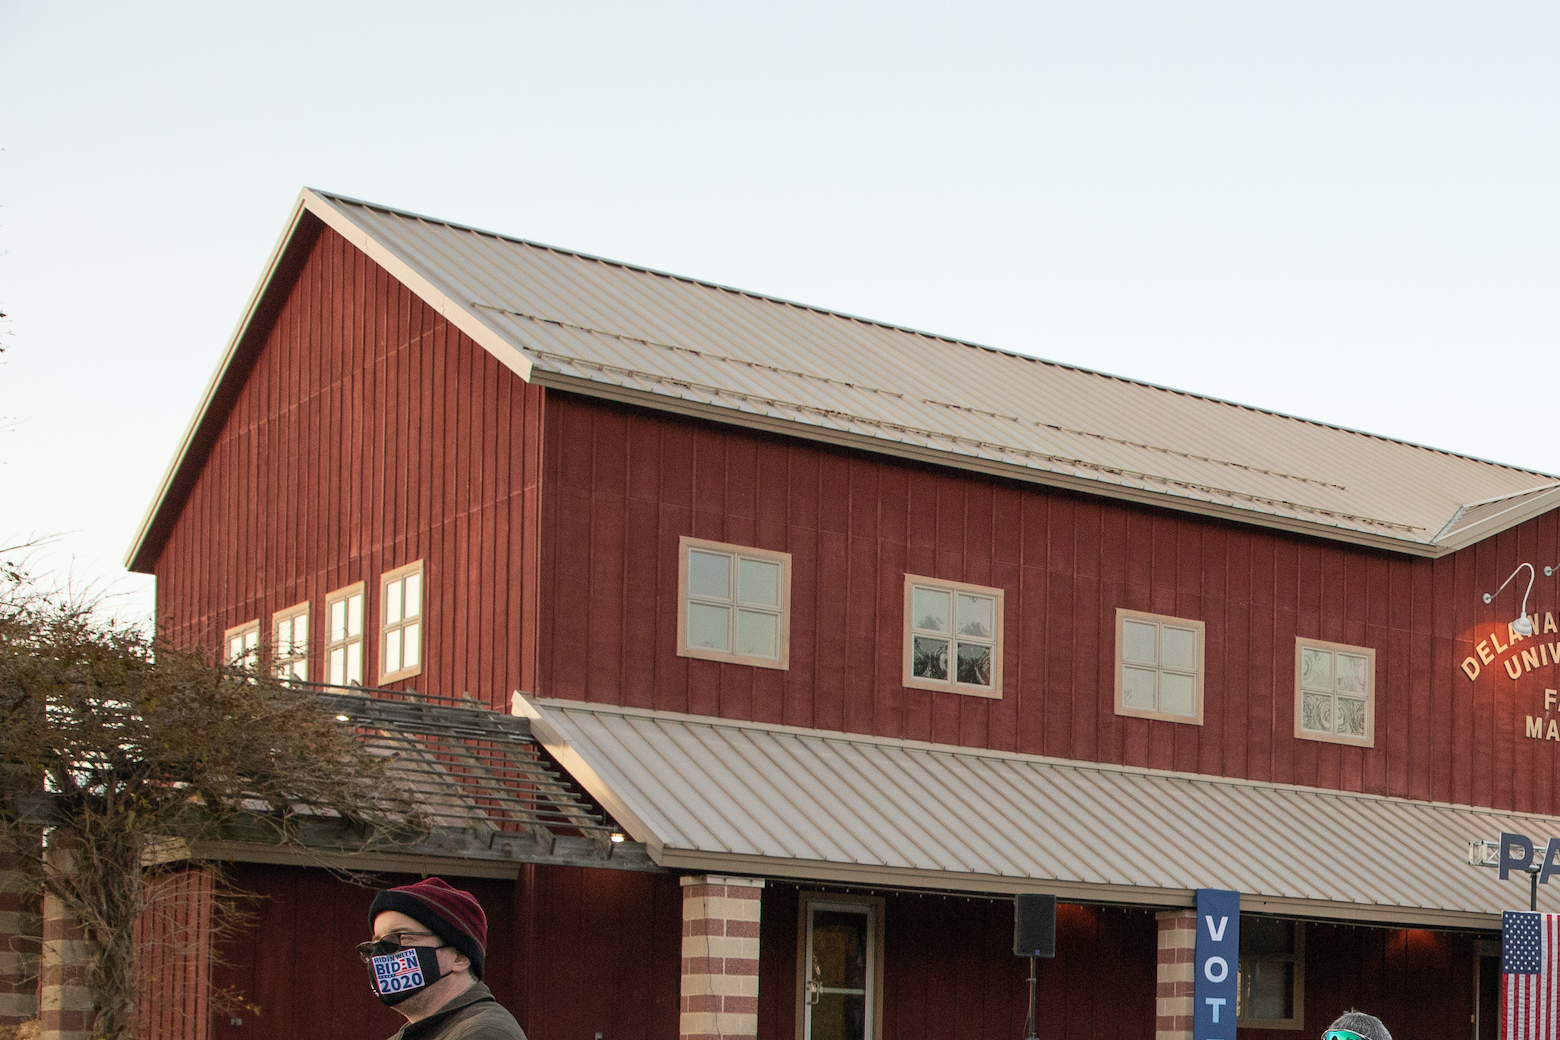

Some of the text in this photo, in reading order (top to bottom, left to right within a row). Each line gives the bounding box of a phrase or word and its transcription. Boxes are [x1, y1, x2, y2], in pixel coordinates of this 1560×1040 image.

[374, 949, 416, 964] RIDIN WITH
[375, 955, 419, 976] BIDEN
[380, 972, 424, 994] 2020
